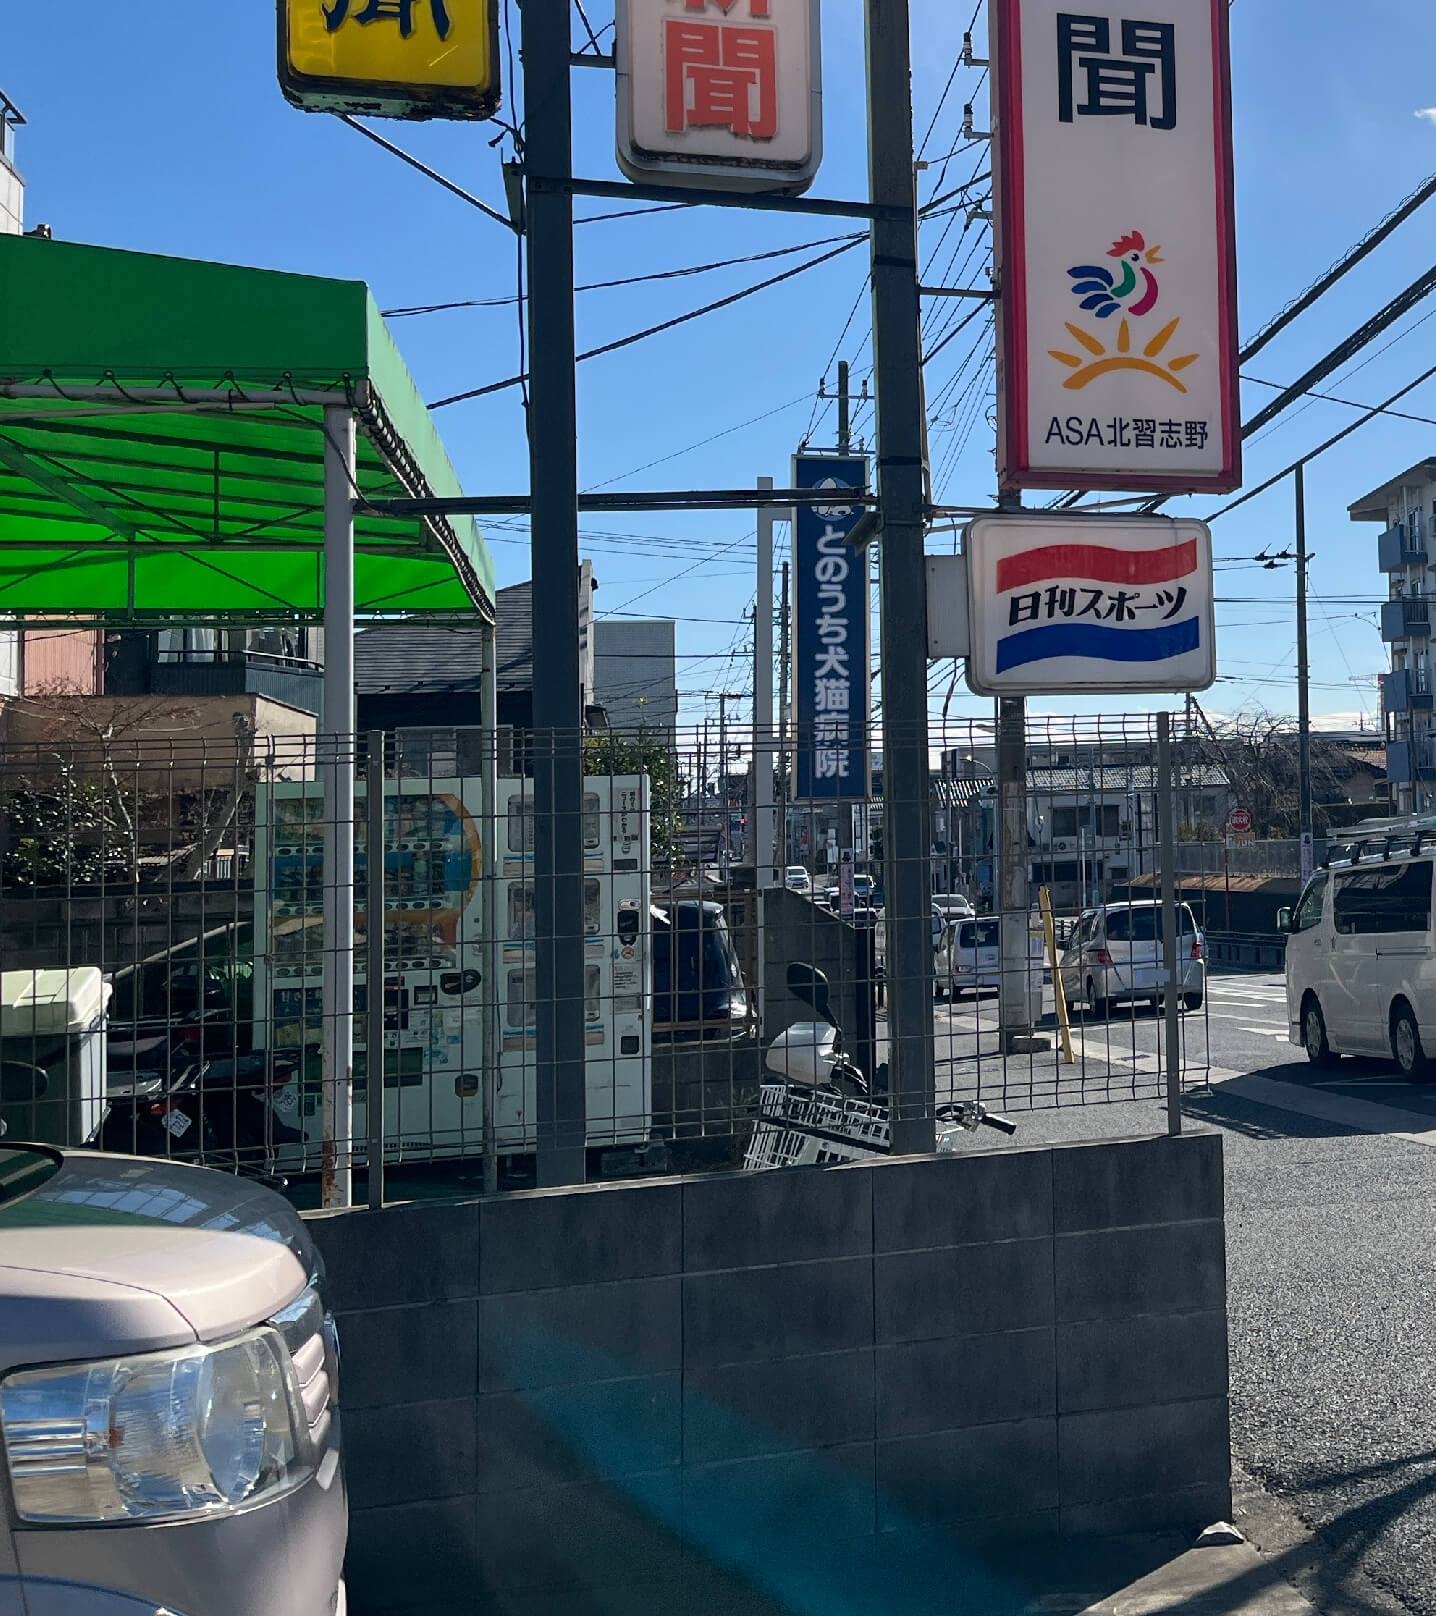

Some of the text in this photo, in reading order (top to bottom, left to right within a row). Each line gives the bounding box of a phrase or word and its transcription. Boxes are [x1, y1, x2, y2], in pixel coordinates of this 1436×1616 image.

[665, 0, 776, 138] 聞
[1057, 13, 1177, 130] 聞
[1045, 416, 1208, 449] ASA北習志野
[814, 525, 850, 779] とのうち犬猫病院
[1008, 584, 1188, 626] 日刊スポーツ
